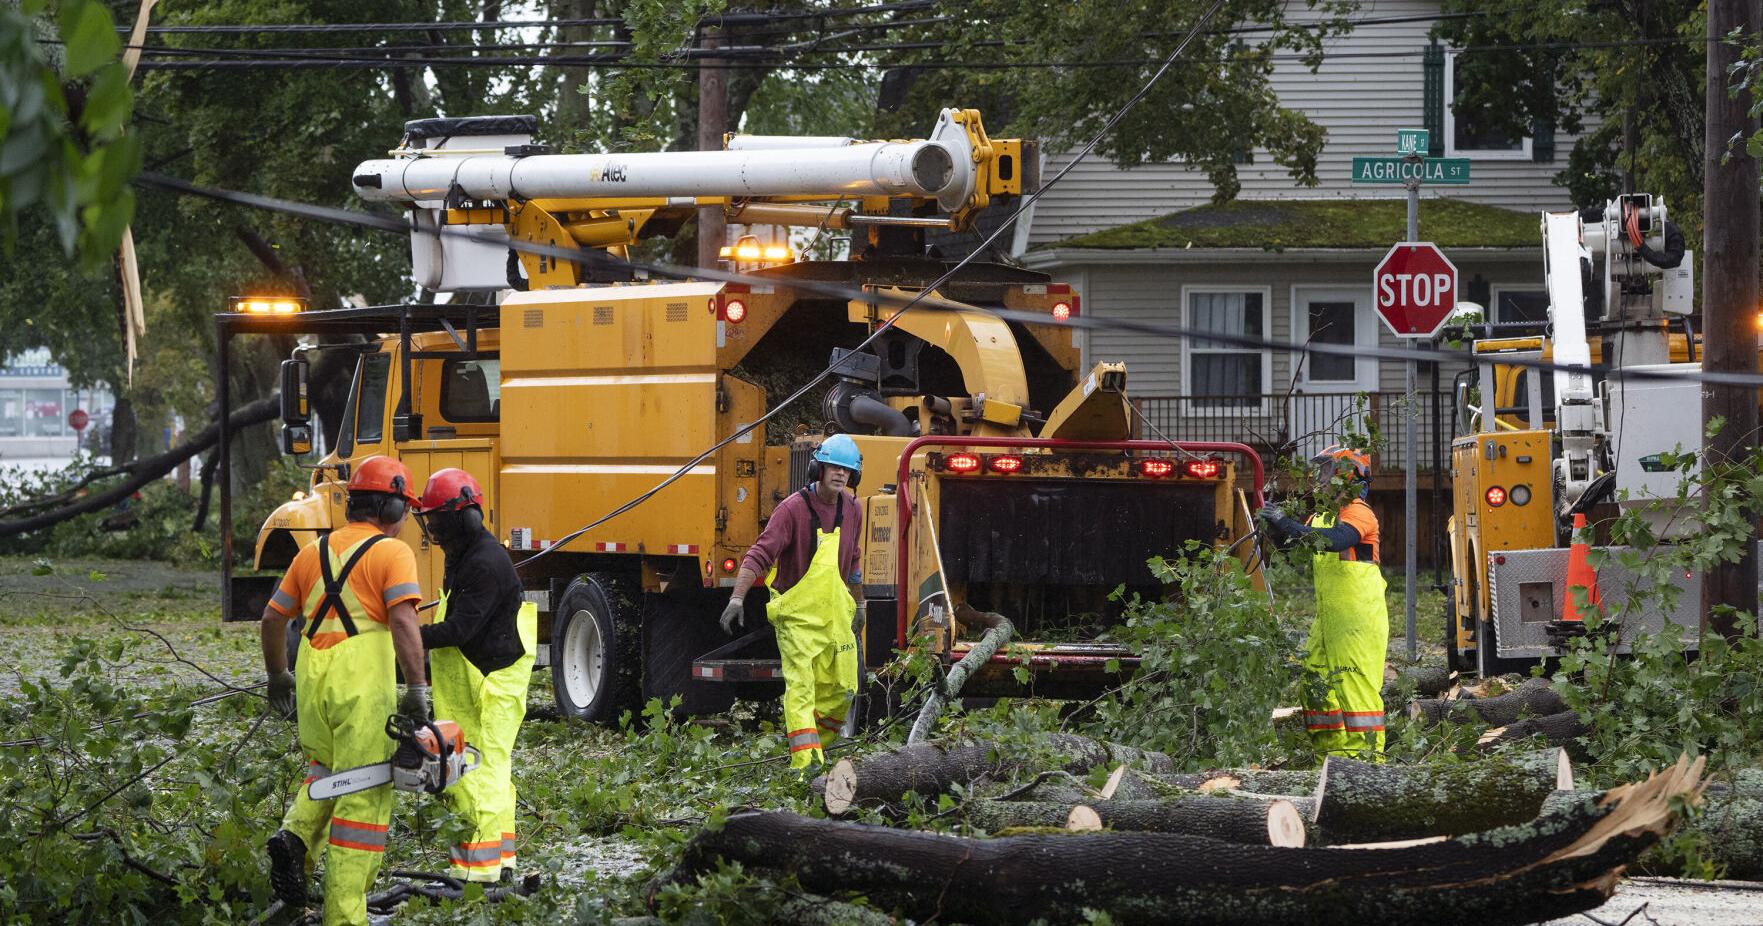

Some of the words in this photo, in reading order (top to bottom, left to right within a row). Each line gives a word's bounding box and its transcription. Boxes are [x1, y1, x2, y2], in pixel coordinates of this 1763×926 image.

[1401, 134, 1417, 151] KANE
[1361, 162, 1444, 179] AGRICOLA
[1450, 166, 1461, 176] ST
[1380, 273, 1451, 307] STOP
[332, 778, 352, 789] STIHL
